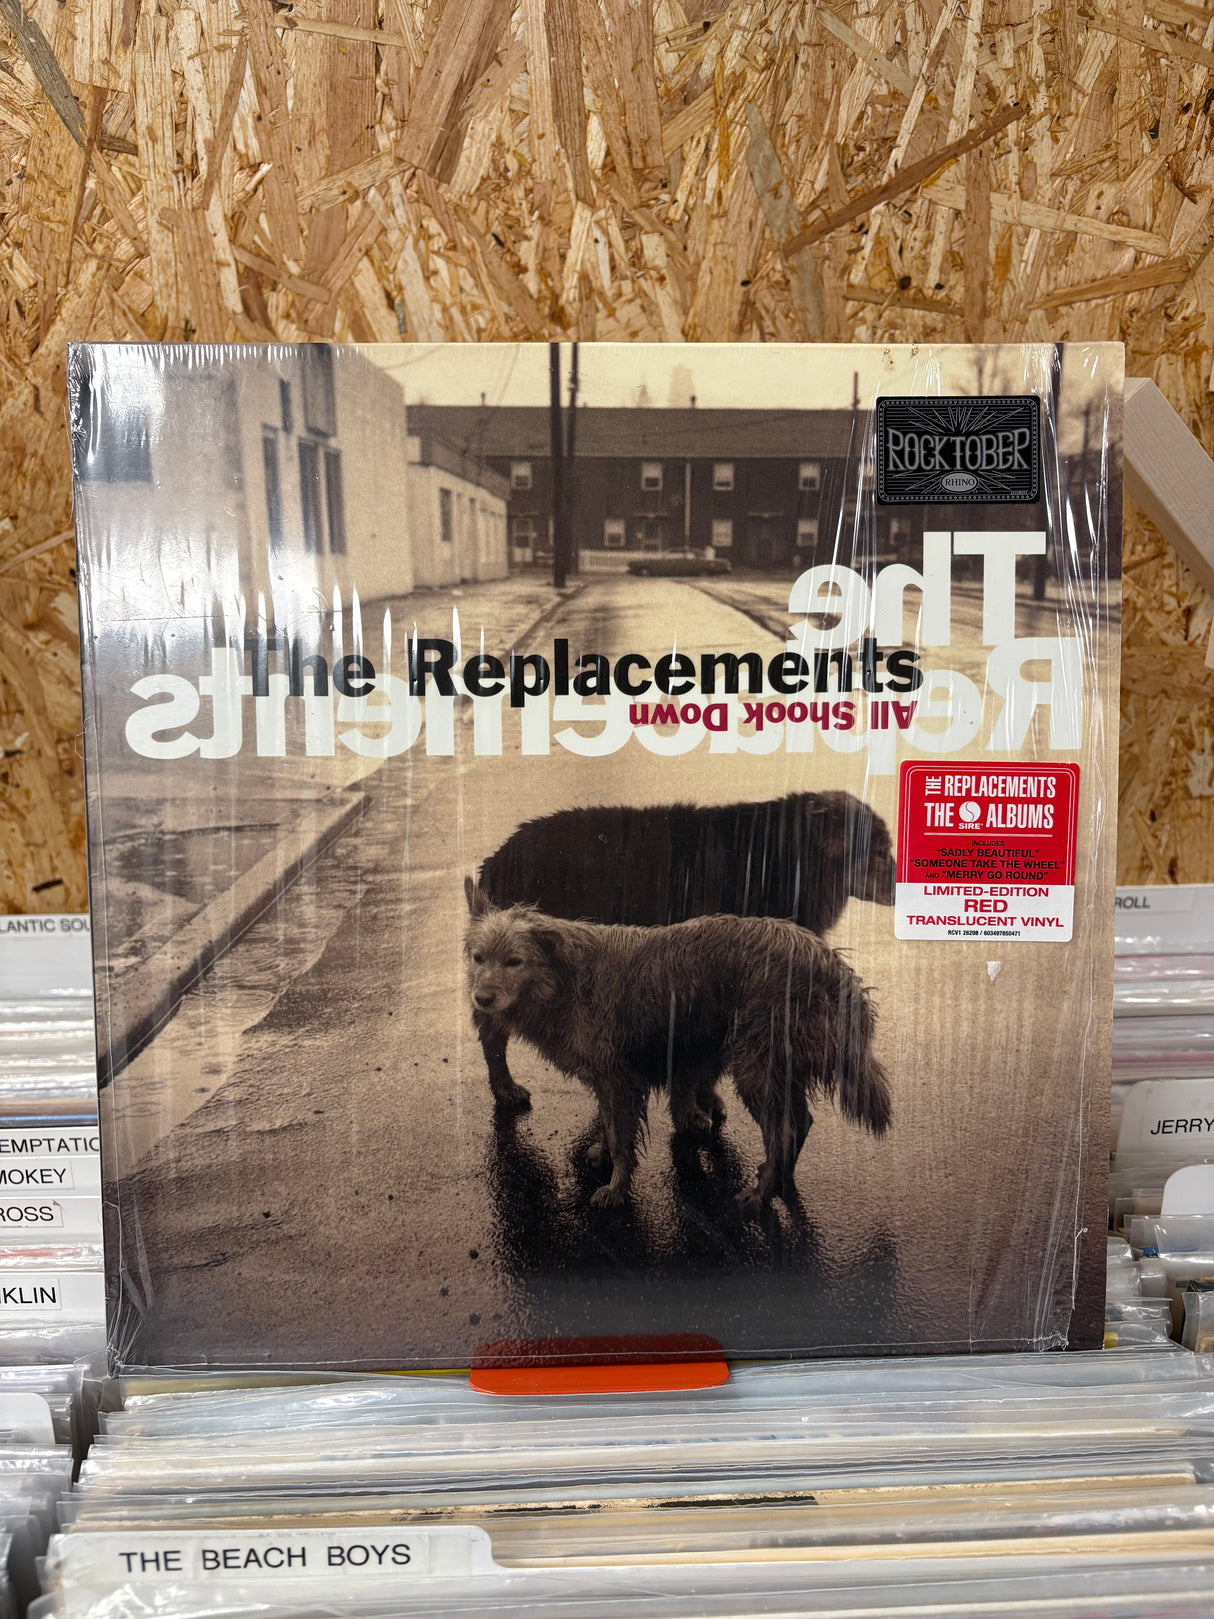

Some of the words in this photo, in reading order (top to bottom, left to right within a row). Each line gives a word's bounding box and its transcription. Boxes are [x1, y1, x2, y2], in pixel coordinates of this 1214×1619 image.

[886, 428, 1031, 471] ROCKTOBER
[945, 475, 975, 486] RHINO
[242, 638, 377, 697] The
[407, 636, 924, 708] Replacements
[628, 702, 728, 732] Down
[742, 701, 856, 732] Shook
[870, 700, 918, 730] All
[925, 775, 942, 796] THE
[944, 775, 1056, 798] REPLACEMENTS
[924, 802, 954, 827] THE
[986, 803, 1054, 829] ALBUMS
[958, 822, 981, 830] SIRE
[970, 859, 998, 869] TAKE
[1000, 860, 1022, 869] THE
[987, 870, 1003, 880] GO
[923, 886, 1049, 897] LIMITED-EDITION
[963, 899, 1008, 913] RED
[906, 915, 1017, 927] TRANSLUCENT
[1021, 917, 1064, 927] VINYL
[1150, 1117, 1214, 1135] JERRY
[0, 1287, 57, 1304] KLIN
[119, 1550, 183, 1573] THE
[202, 1547, 307, 1571] BEACH
[327, 1543, 411, 1567] BOYS
